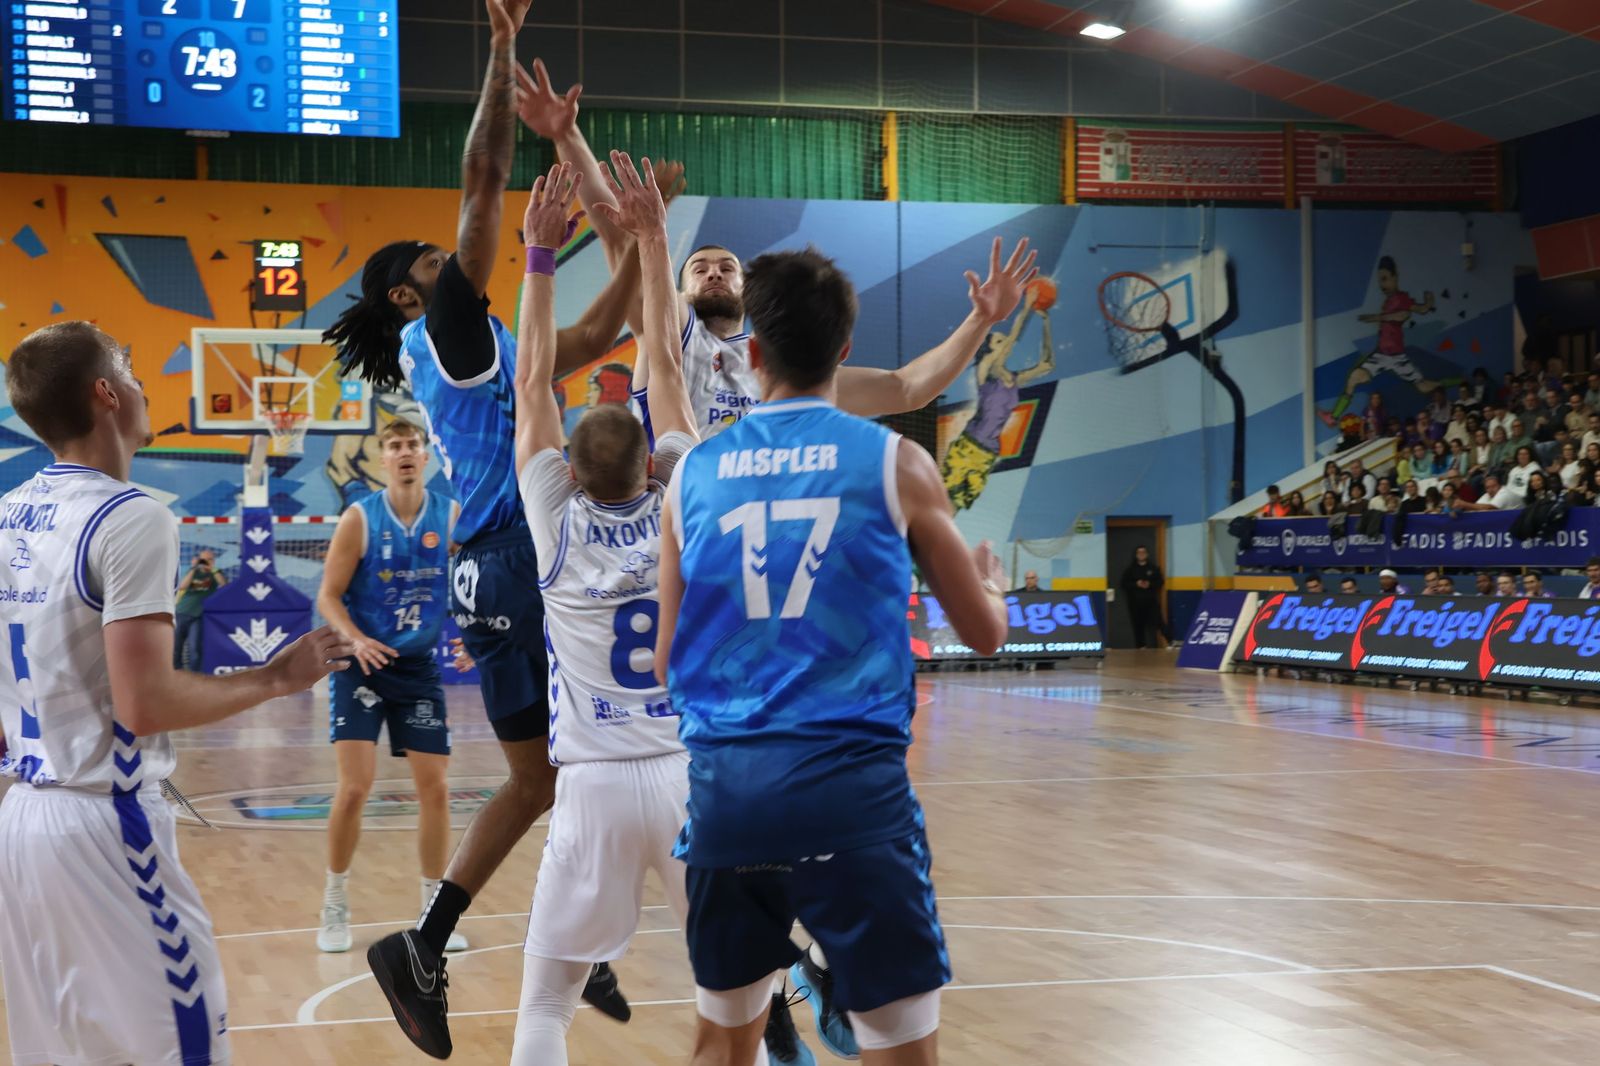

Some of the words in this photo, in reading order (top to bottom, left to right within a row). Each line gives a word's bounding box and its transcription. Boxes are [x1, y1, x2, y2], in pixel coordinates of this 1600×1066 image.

[112, 24, 122, 37] 2
[181, 46, 237, 78] 7:43
[148, 82, 162, 103] 0
[252, 87, 266, 108] 2
[261, 242, 300, 258] 7:43
[259, 268, 299, 296] 12
[717, 444, 839, 480] NASPLER
[1463, 531, 1514, 549] FADIS
[718, 496, 841, 620] 17
[393, 604, 423, 632] 14
[1267, 595, 1373, 641] Freigel
[1376, 598, 1501, 648] Freigel
[611, 599, 661, 690] 8
[1045, 641, 1102, 652] COMPANY
[1500, 664, 1546, 678] GOODLIFE
[1542, 667, 1576, 681] FOODS
